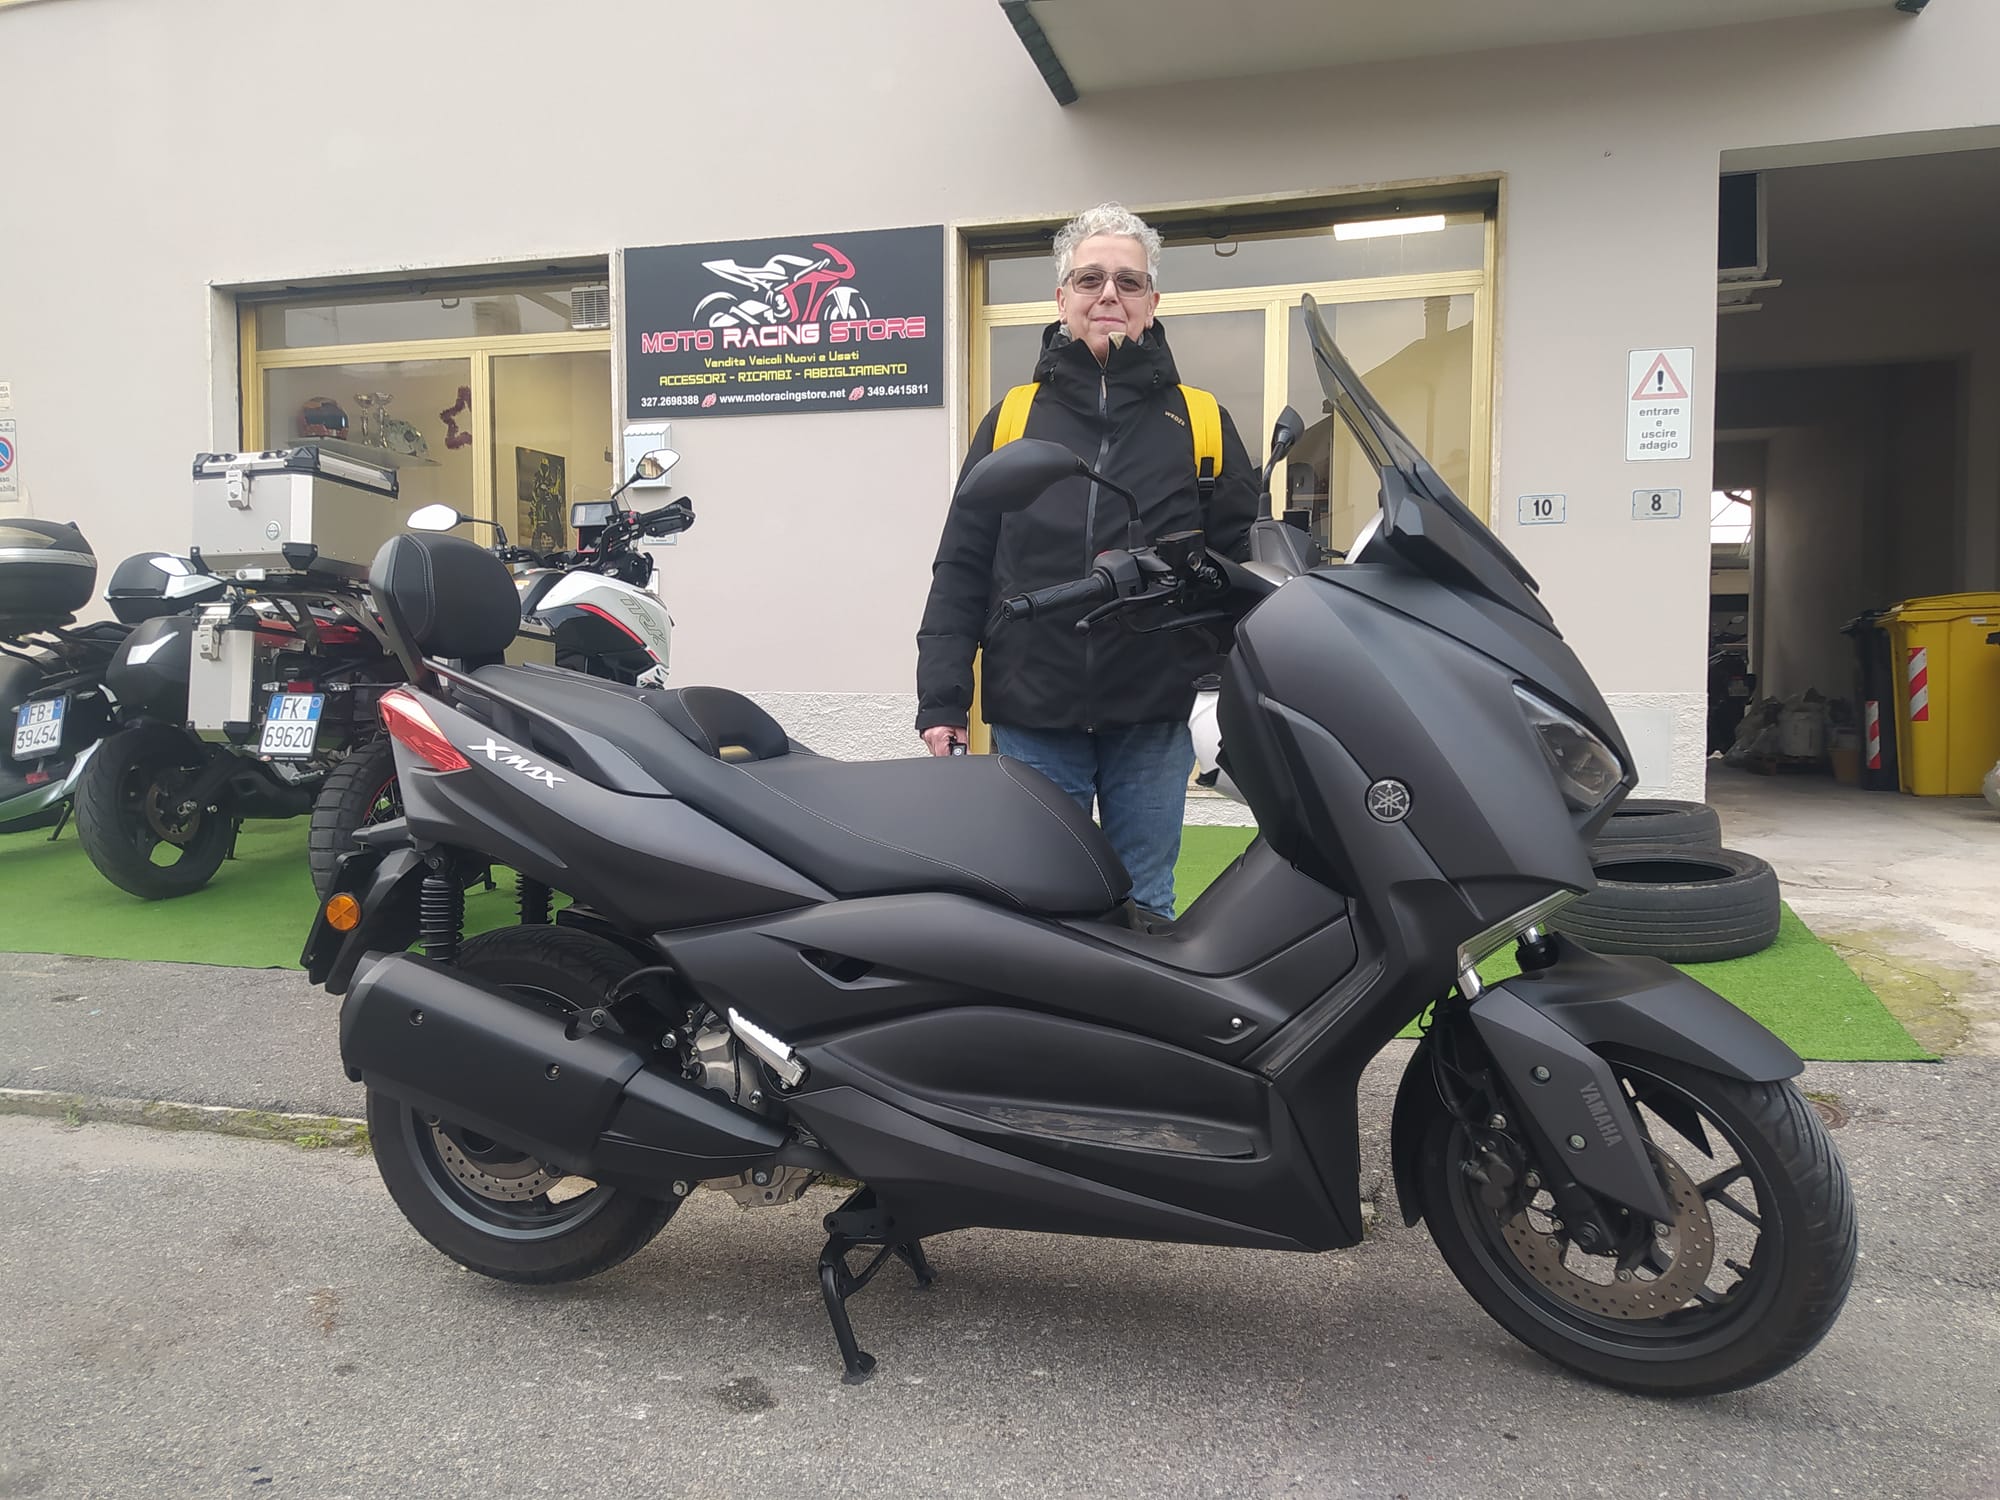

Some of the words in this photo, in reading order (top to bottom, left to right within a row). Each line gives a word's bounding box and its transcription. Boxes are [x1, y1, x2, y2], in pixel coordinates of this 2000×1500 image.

[641, 329, 714, 354] MOTO
[723, 323, 820, 350] RACING
[829, 316, 926, 343] STORE
[704, 356, 746, 369] Vendita
[748, 354, 782, 366] Veicoli
[785, 352, 816, 364] Nuovi
[818, 354, 826, 362] e
[828, 350, 860, 362] Usati
[659, 372, 727, 387] ACCESSORI
[737, 369, 792, 383] RICAMBI
[803, 363, 908, 379] ABBIGLIAMENTO
[641, 395, 699, 407] 327.2698388
[719, 388, 846, 404] www.motoracingstore.net
[867, 383, 929, 397] 349.6415811
[1639, 407, 1680, 417] entrare
[1641, 428, 1677, 439] uscire
[1655, 419, 1663, 427] e
[1639, 440, 1678, 451] adagio
[1533, 498, 1553, 517] 10
[1651, 493, 1662, 512] 8
[29, 704, 46, 724] FB
[280, 697, 302, 719] FK
[17, 723, 58, 749] 39454
[264, 726, 314, 748] 69620
[466, 737, 568, 789] XMAX
[1580, 1081, 1623, 1147] YAMAHA
